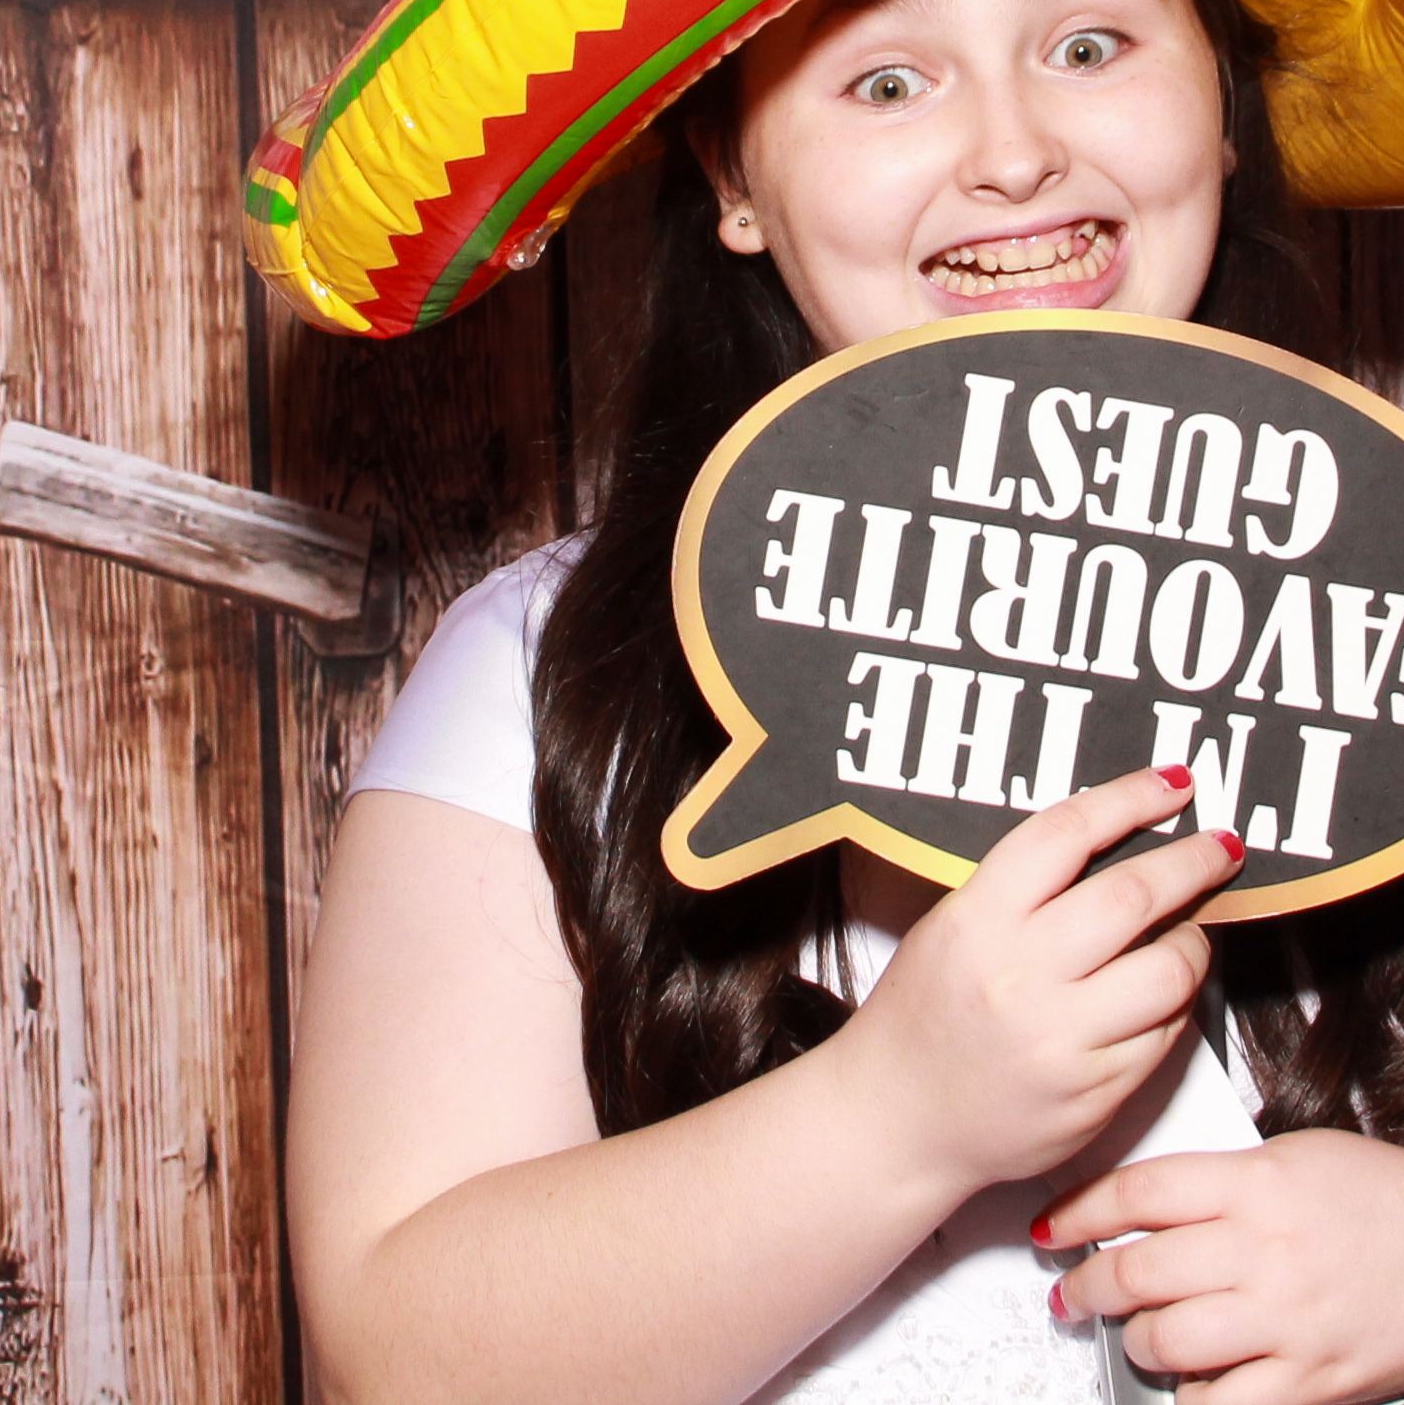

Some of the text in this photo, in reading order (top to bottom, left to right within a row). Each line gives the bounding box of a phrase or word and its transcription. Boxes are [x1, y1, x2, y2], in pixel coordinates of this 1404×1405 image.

[931, 372, 1341, 561] GUEST
[836, 651, 1352, 860] I'M THE
